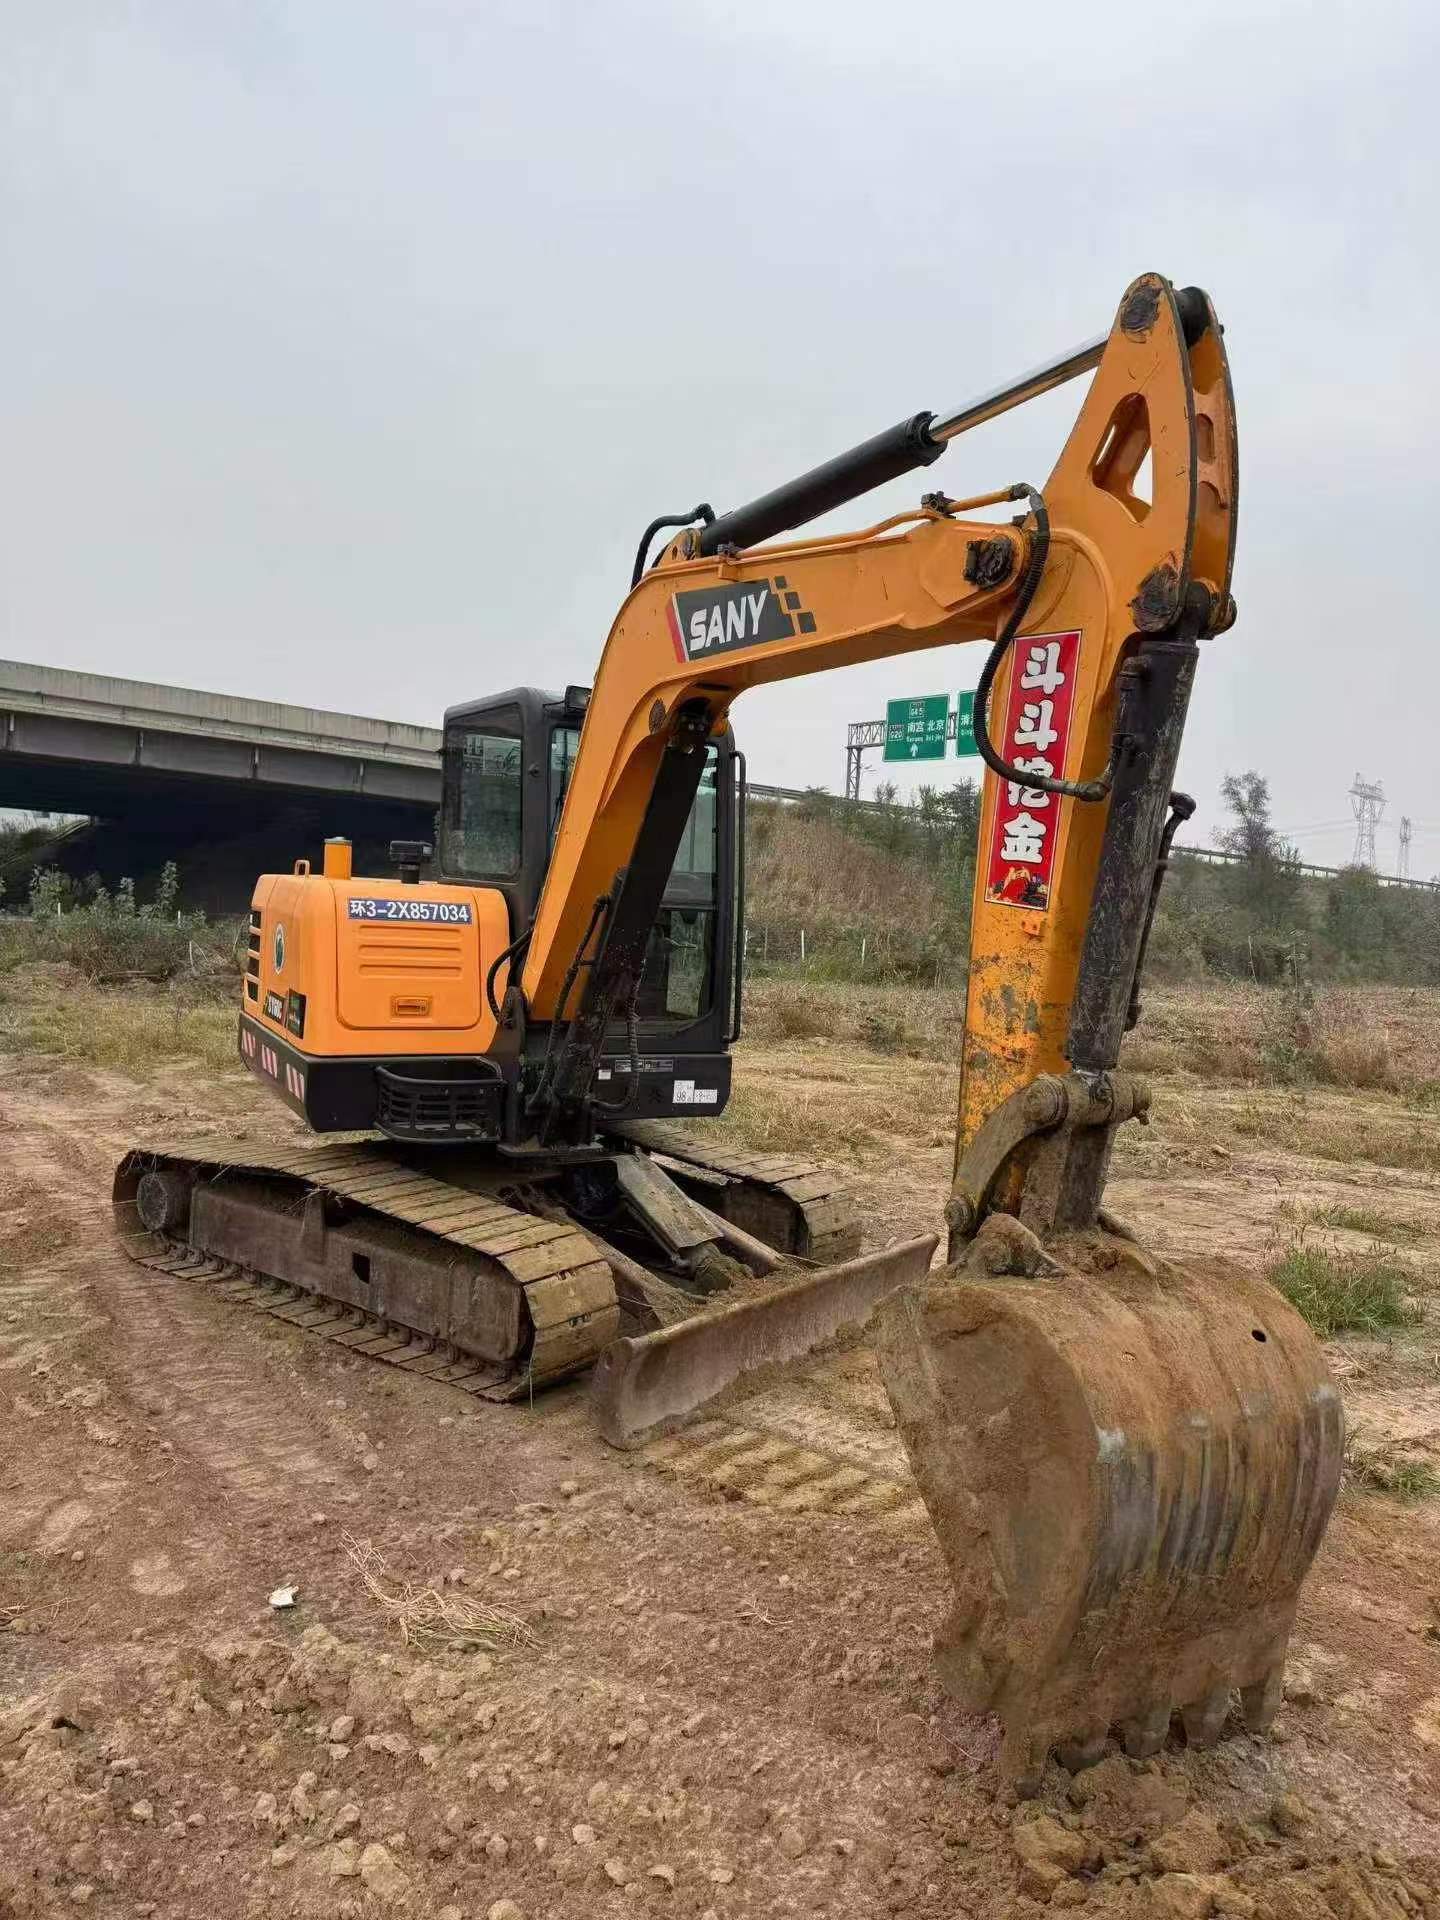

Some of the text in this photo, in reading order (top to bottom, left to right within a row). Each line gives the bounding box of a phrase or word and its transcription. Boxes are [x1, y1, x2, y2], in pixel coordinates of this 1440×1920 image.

[690, 590, 768, 651] SANY
[927, 719, 945, 732] 北京
[350, 899, 470, 922] 环3-2X857034
